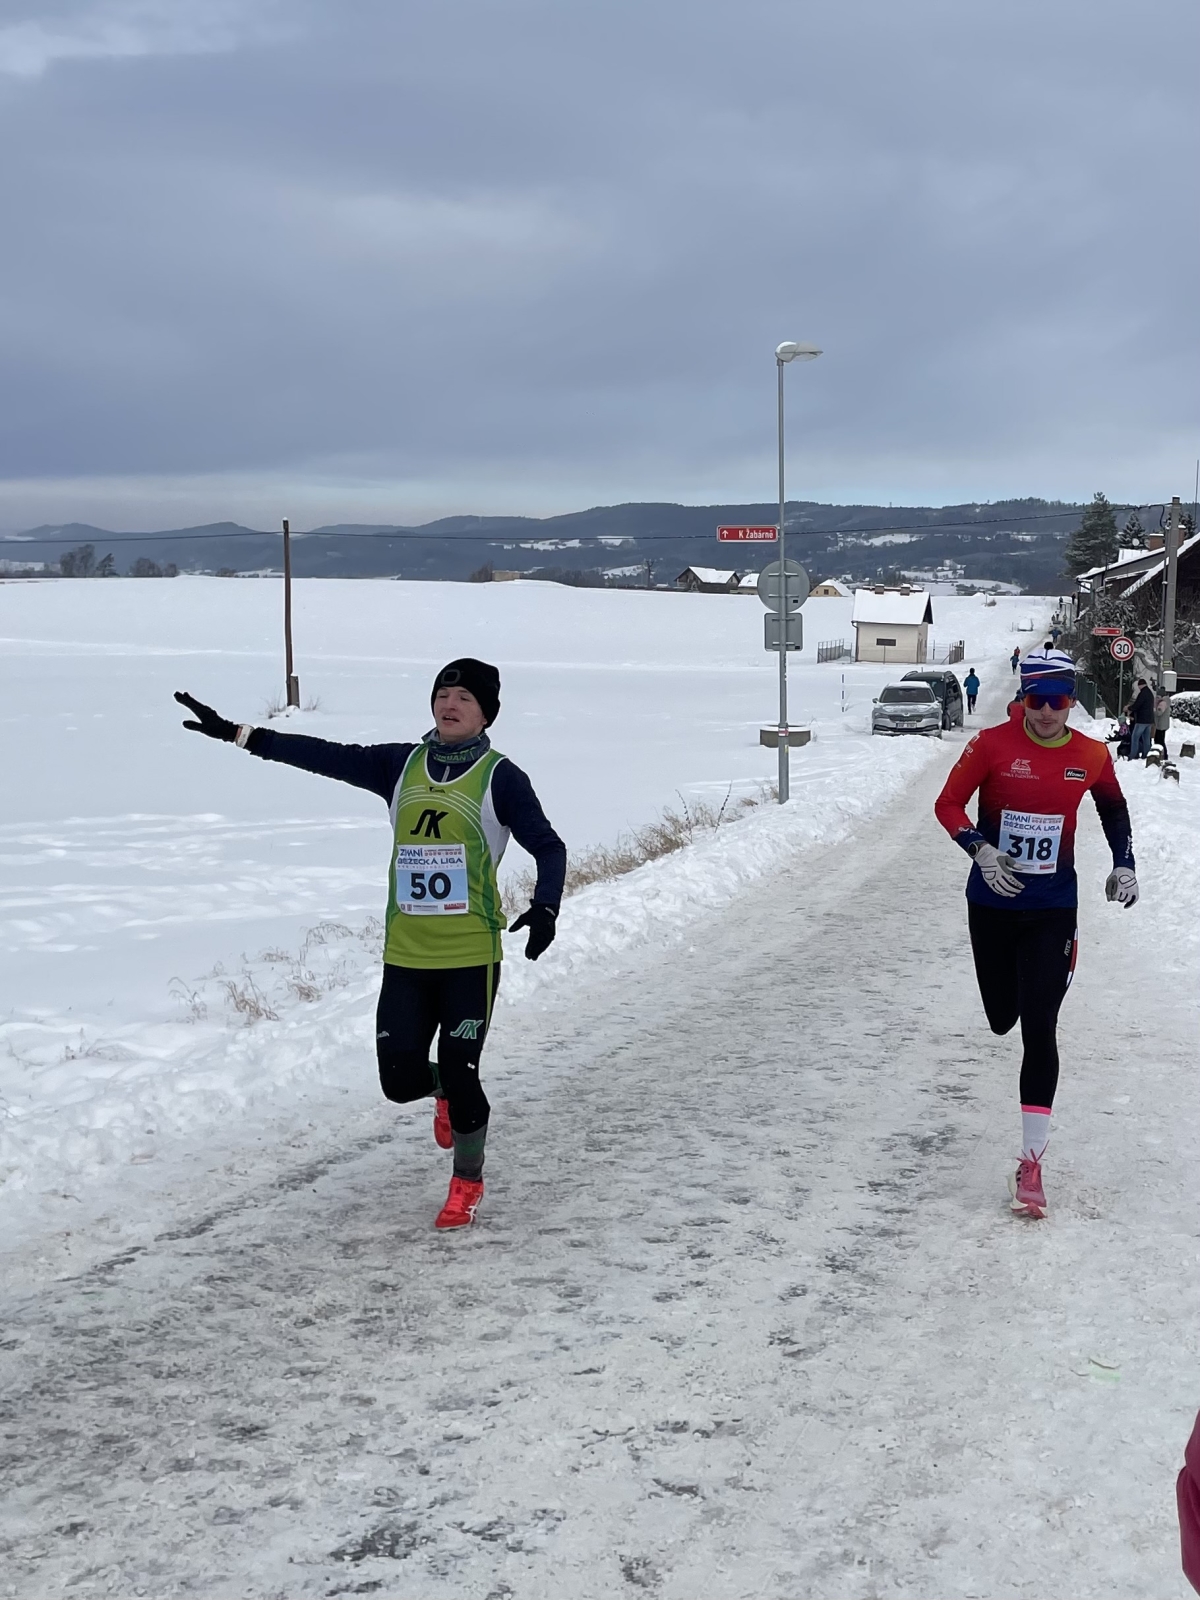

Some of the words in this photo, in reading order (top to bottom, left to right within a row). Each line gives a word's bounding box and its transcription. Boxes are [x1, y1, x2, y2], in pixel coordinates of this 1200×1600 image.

[738, 530, 744, 539] K
[1116, 643, 1130, 655] 30
[1003, 813, 1031, 823] ZIMNÍ
[1003, 821, 1042, 831] BĚŽECKÁ
[399, 847, 423, 857] ZIMNÍ
[1006, 833, 1053, 861] 318
[397, 857, 439, 865] BĚŽECKÁ
[440, 857, 463, 865] LIGA
[410, 872, 452, 900] 50
